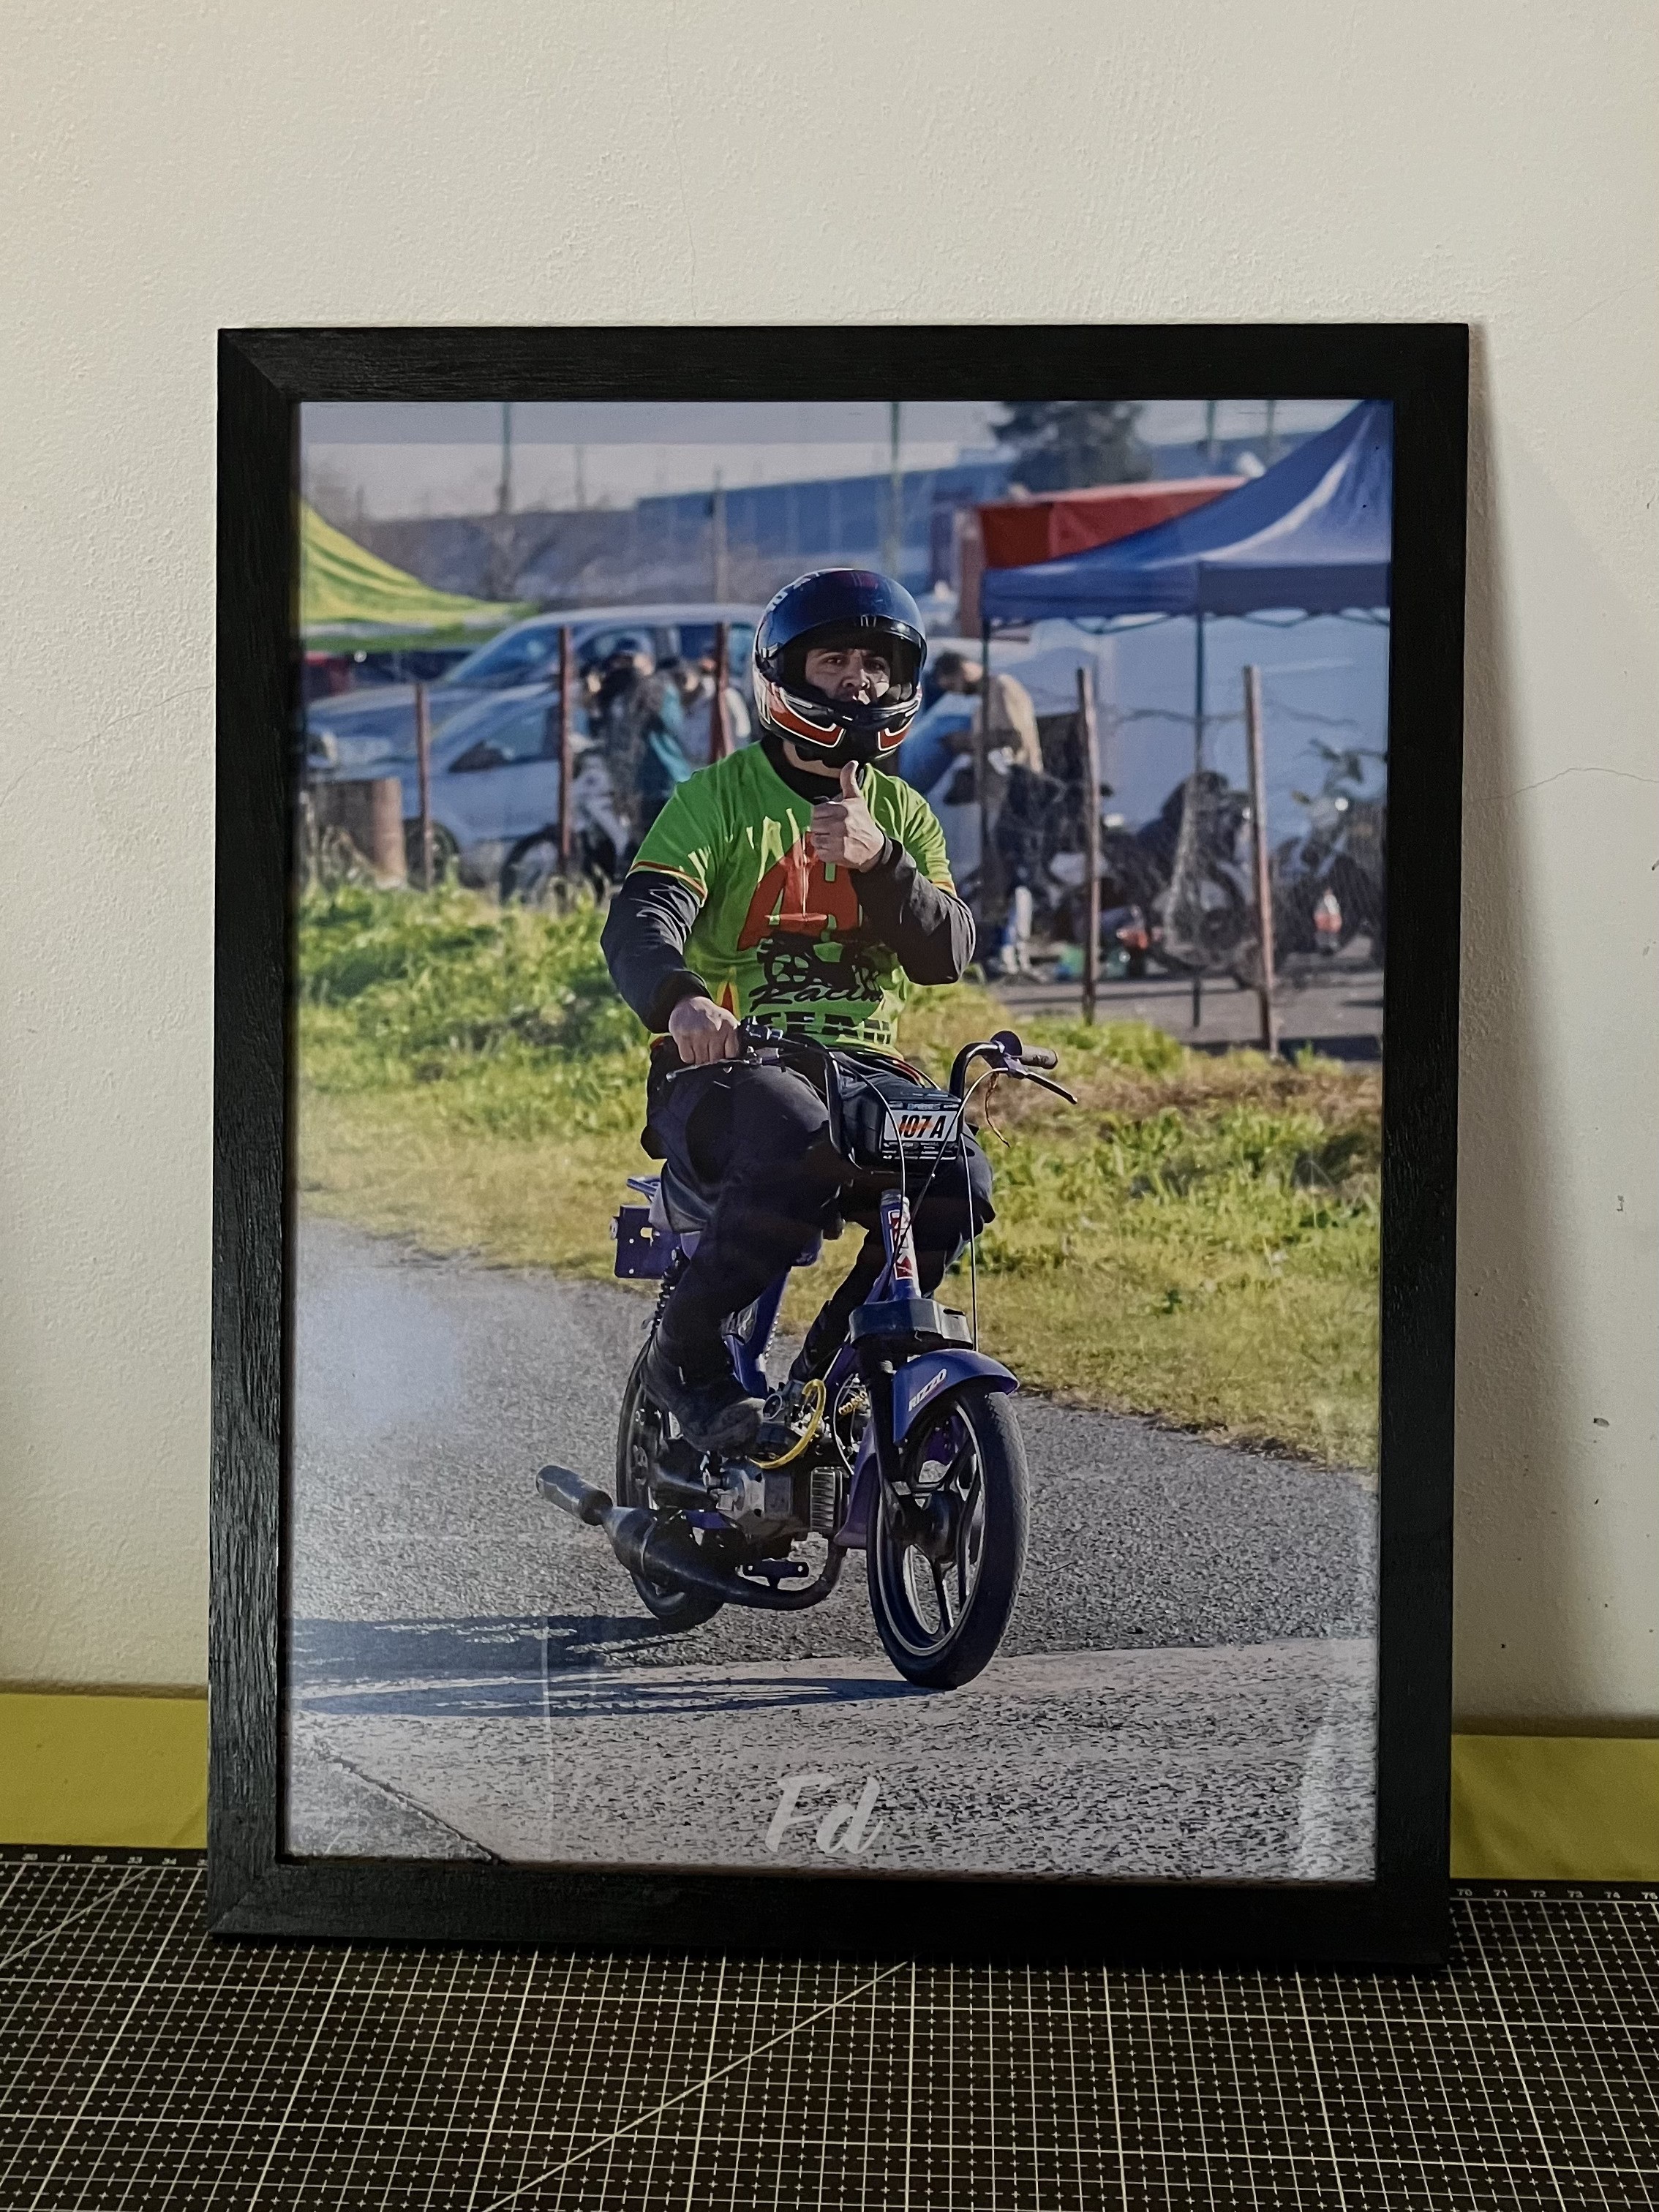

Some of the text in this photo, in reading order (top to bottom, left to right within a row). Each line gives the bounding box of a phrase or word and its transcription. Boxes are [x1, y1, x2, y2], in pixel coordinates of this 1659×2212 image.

[898, 1114, 947, 1139] 107 A
[908, 1368, 947, 1412] RIZZO
[1456, 1888, 1473, 1897] 70
[1493, 1889, 1508, 1897] 71
[1530, 1889, 1547, 1898] 72
[1567, 1889, 1584, 1899] 73
[1604, 1891, 1621, 1900] 74
